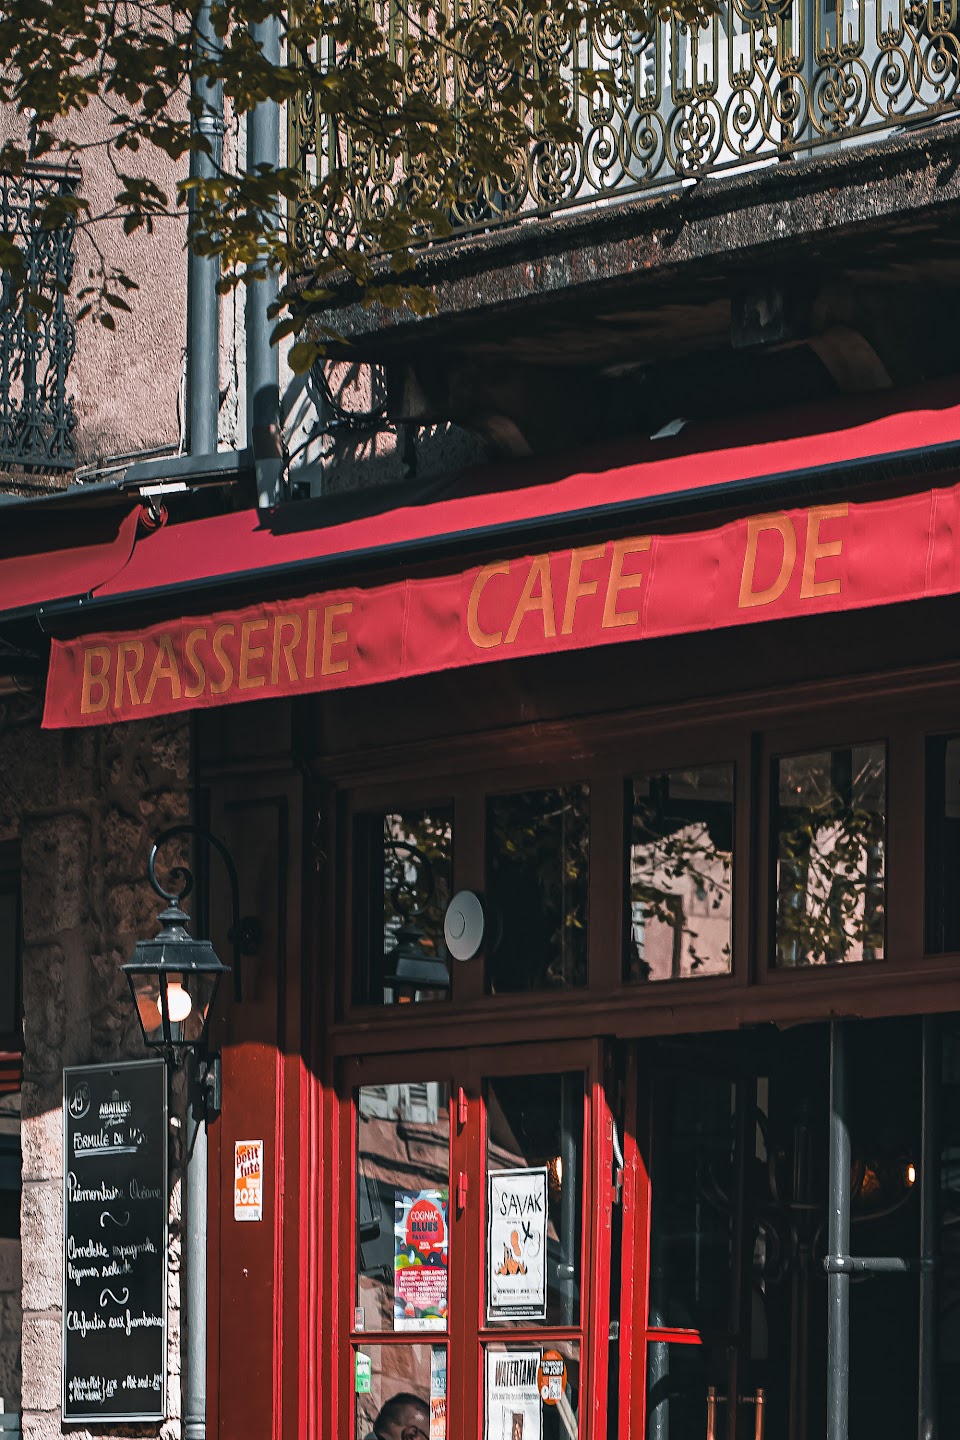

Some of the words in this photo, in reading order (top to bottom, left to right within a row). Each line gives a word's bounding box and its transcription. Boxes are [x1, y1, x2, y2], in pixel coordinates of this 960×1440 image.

[79, 602, 353, 714] BRASSERIE
[466, 536, 652, 650] CAFE
[738, 502, 850, 609] DE
[99, 1101, 131, 1115] ABATILLES
[500, 1192, 542, 1217] SAVAK
[410, 1210, 439, 1221] COGNAC
[411, 1221, 438, 1232] BLUES
